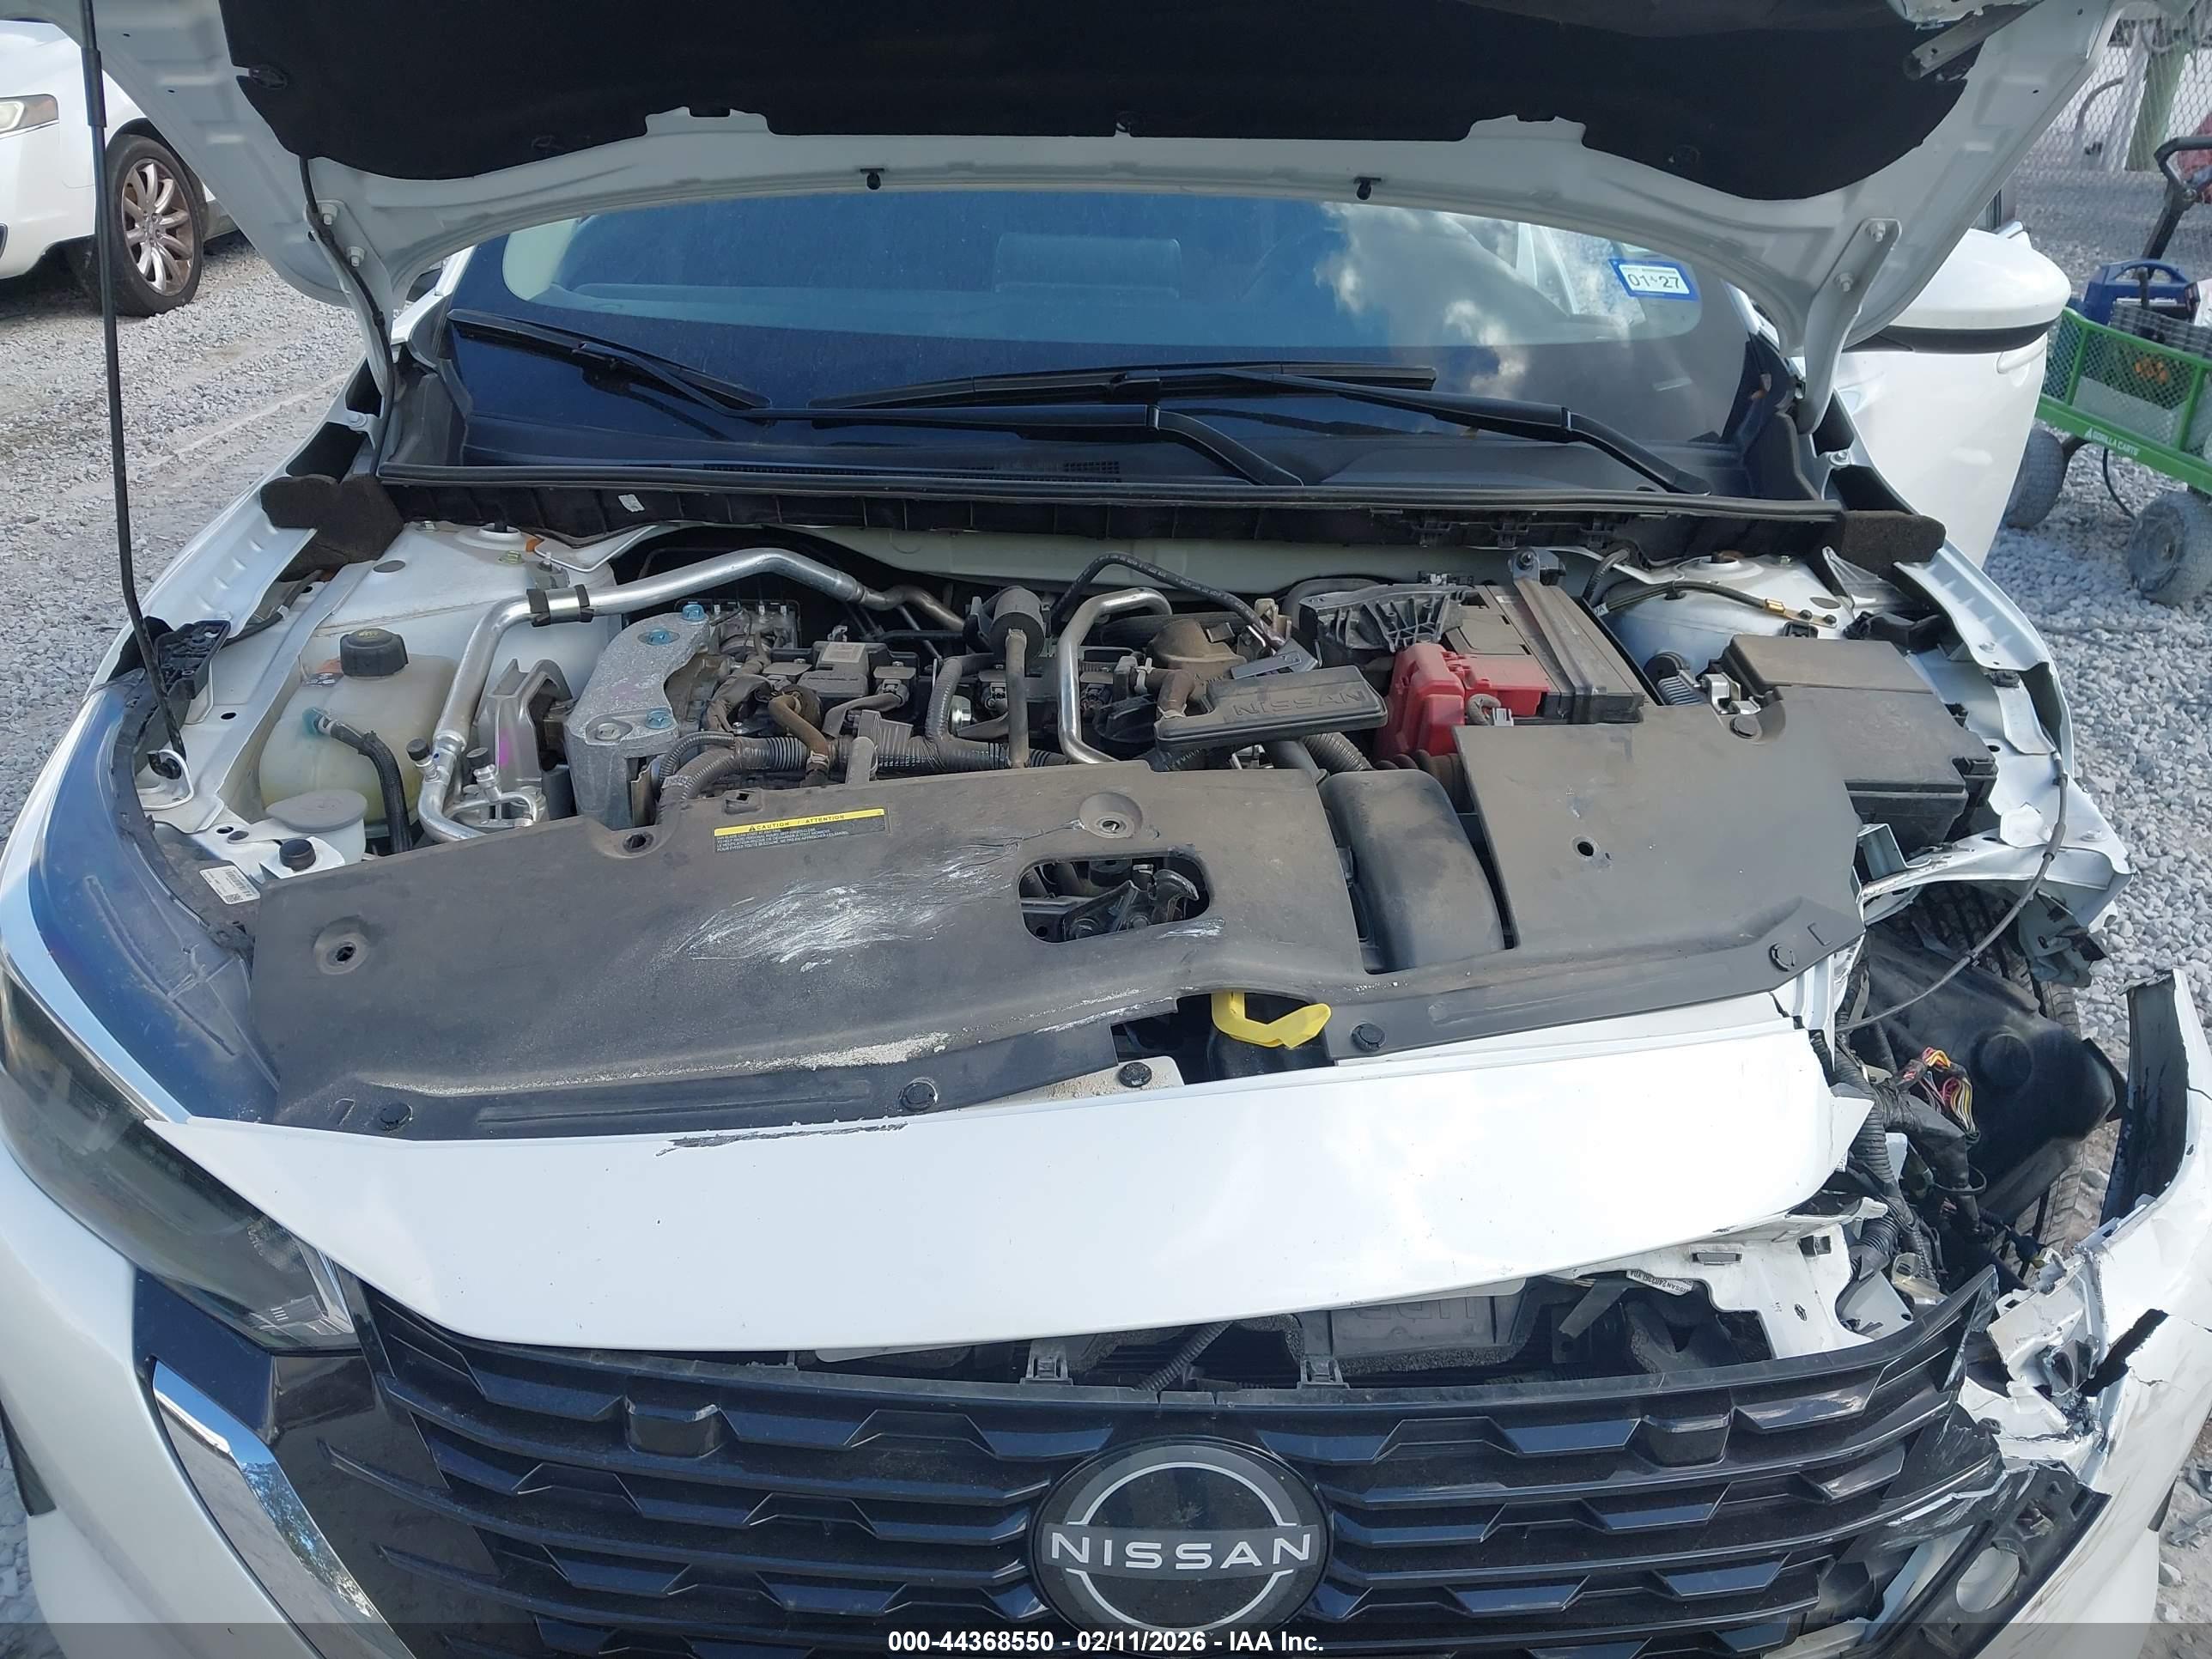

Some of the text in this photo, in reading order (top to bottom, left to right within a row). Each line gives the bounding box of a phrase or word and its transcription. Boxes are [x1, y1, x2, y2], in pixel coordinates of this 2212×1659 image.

[1659, 276, 1680, 289] 27
[1232, 690, 1364, 716] NISSAN
[757, 821, 790, 830] CAUTION
[805, 814, 845, 824] ATTENTION
[1051, 1532, 1311, 1570] NISSAN
